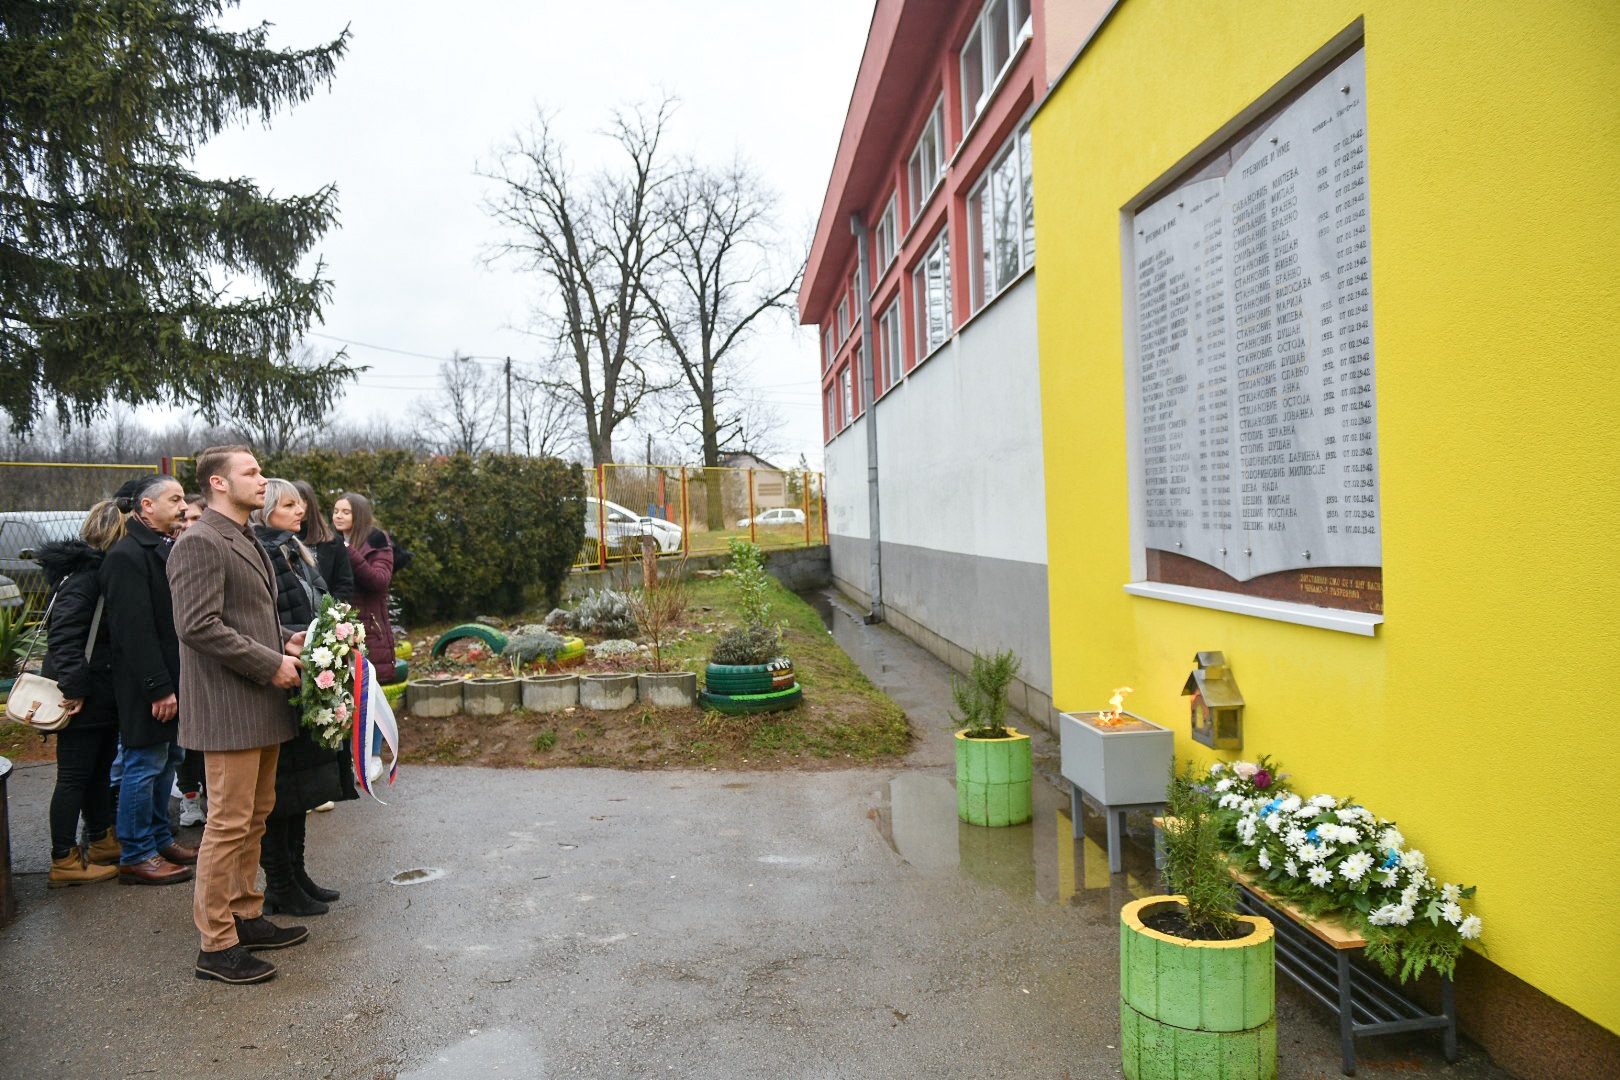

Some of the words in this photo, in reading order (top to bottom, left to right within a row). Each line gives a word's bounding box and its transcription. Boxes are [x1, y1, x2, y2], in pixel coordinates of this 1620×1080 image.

[1241, 154, 1268, 180] ПРЕЗИМЕ
[1276, 139, 1291, 158] ИМЕ
[1276, 307, 1303, 326] МИЛЕВА
[1276, 323, 1301, 340] ДУШАН
[1277, 336, 1305, 354] ОСТОЈА
[1280, 351, 1305, 367] ДУШАН
[1282, 393, 1311, 408] ОСТОЈА
